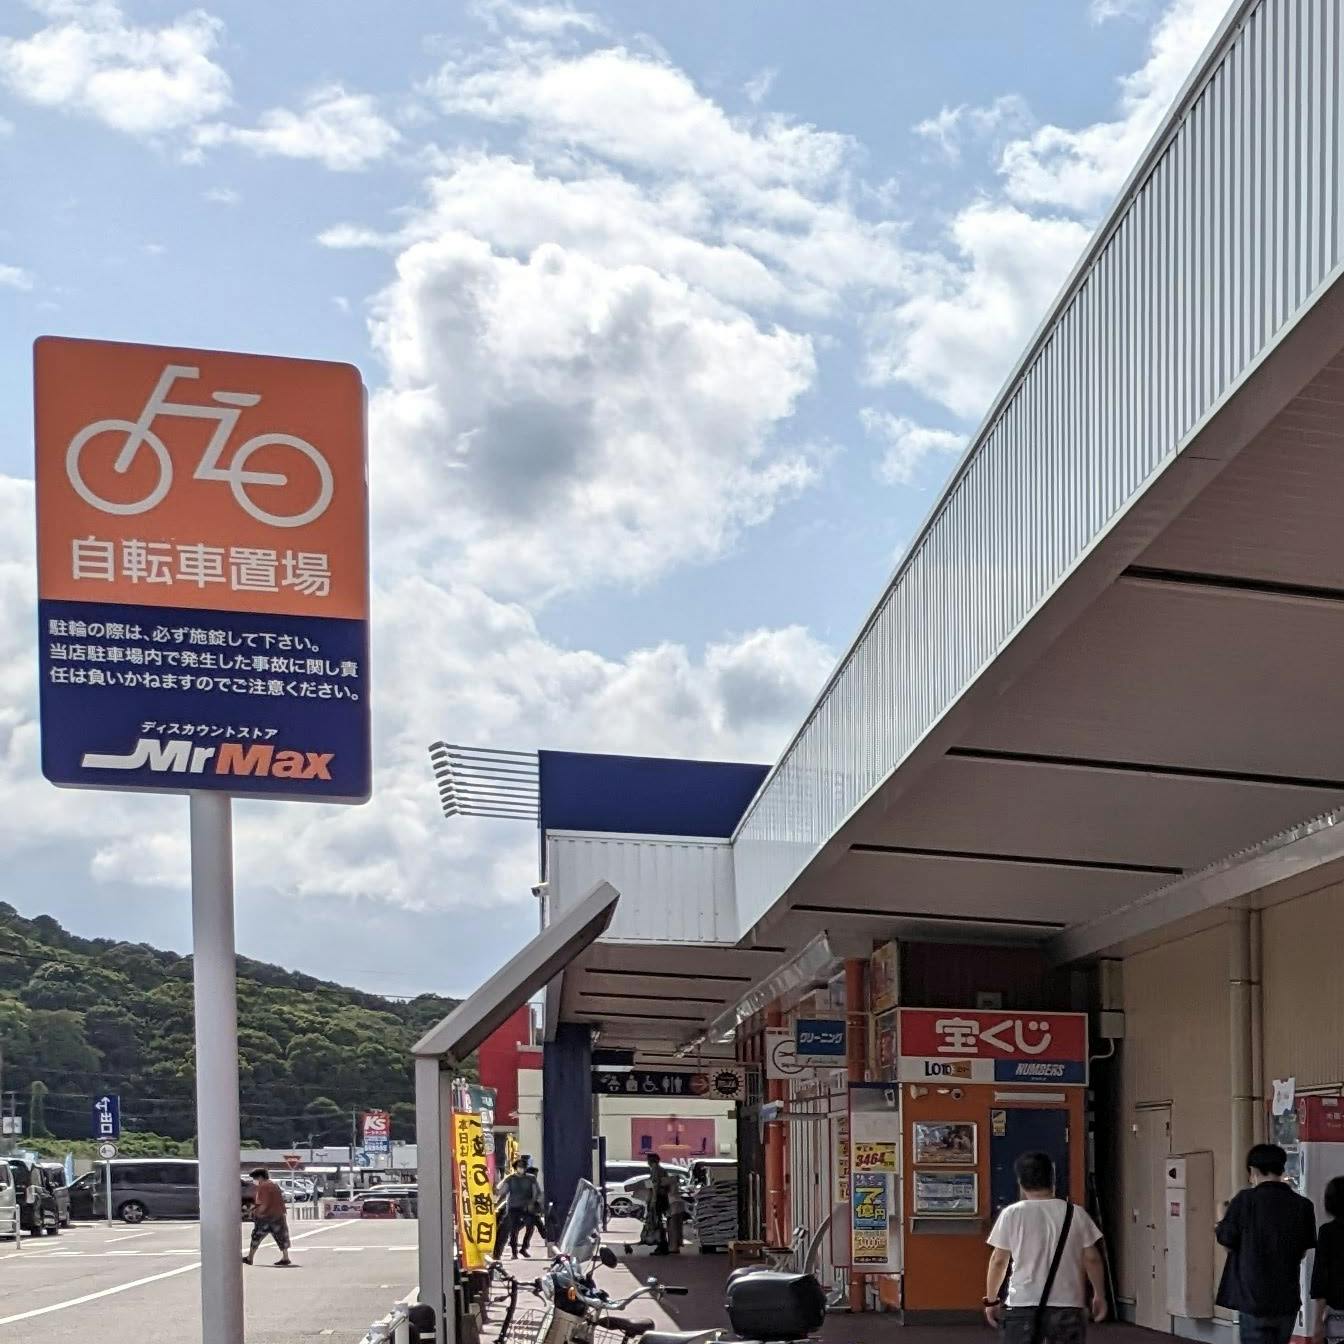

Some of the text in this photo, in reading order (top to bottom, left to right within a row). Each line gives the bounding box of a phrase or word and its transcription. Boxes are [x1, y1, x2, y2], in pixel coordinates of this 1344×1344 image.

[71, 535, 332, 597] 自転車置場
[48, 618, 320, 653] 駐輪の際は、必ず施錠して下さい。
[49, 644, 359, 679] 当店駐車場内で発生した事故に関し責
[49, 666, 360, 702] 任は負いかねますのでご注意ください。
[141, 721, 279, 740] ディスカウントストア
[81, 737, 334, 782] MrMax
[799, 1032, 844, 1044] クリーニング
[935, 1017, 1052, 1055] 宝くじ
[100, 1112, 113, 1134] 出口
